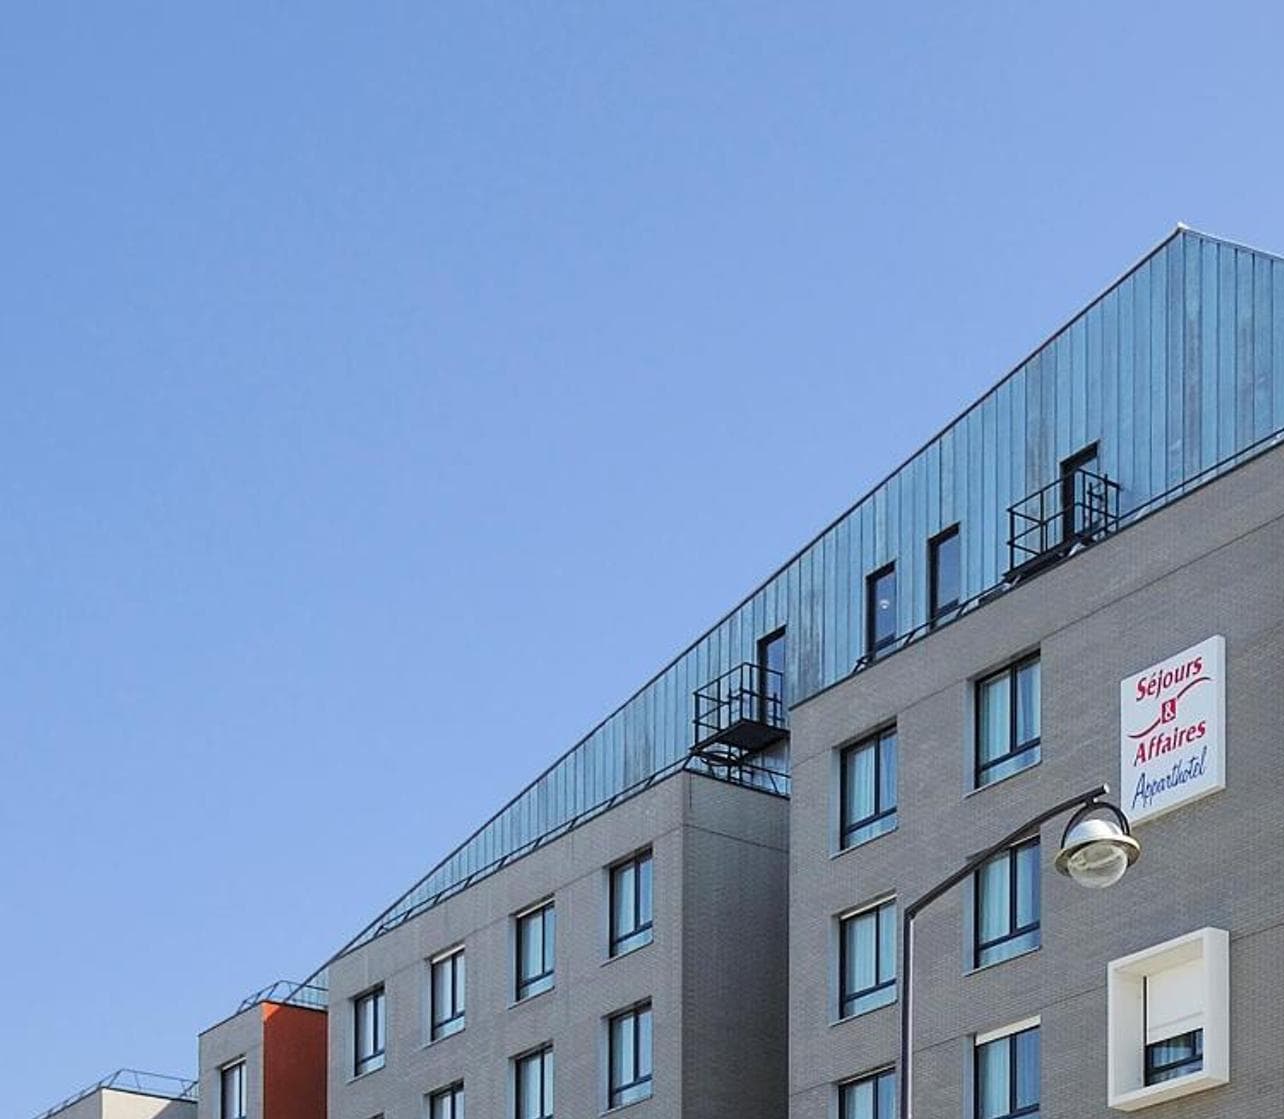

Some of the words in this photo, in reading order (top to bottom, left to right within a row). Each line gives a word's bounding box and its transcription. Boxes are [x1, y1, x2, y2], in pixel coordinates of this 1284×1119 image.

[1136, 656, 1203, 702] Séjours
[1162, 699, 1175, 722] &
[1134, 720, 1206, 767] Affaires
